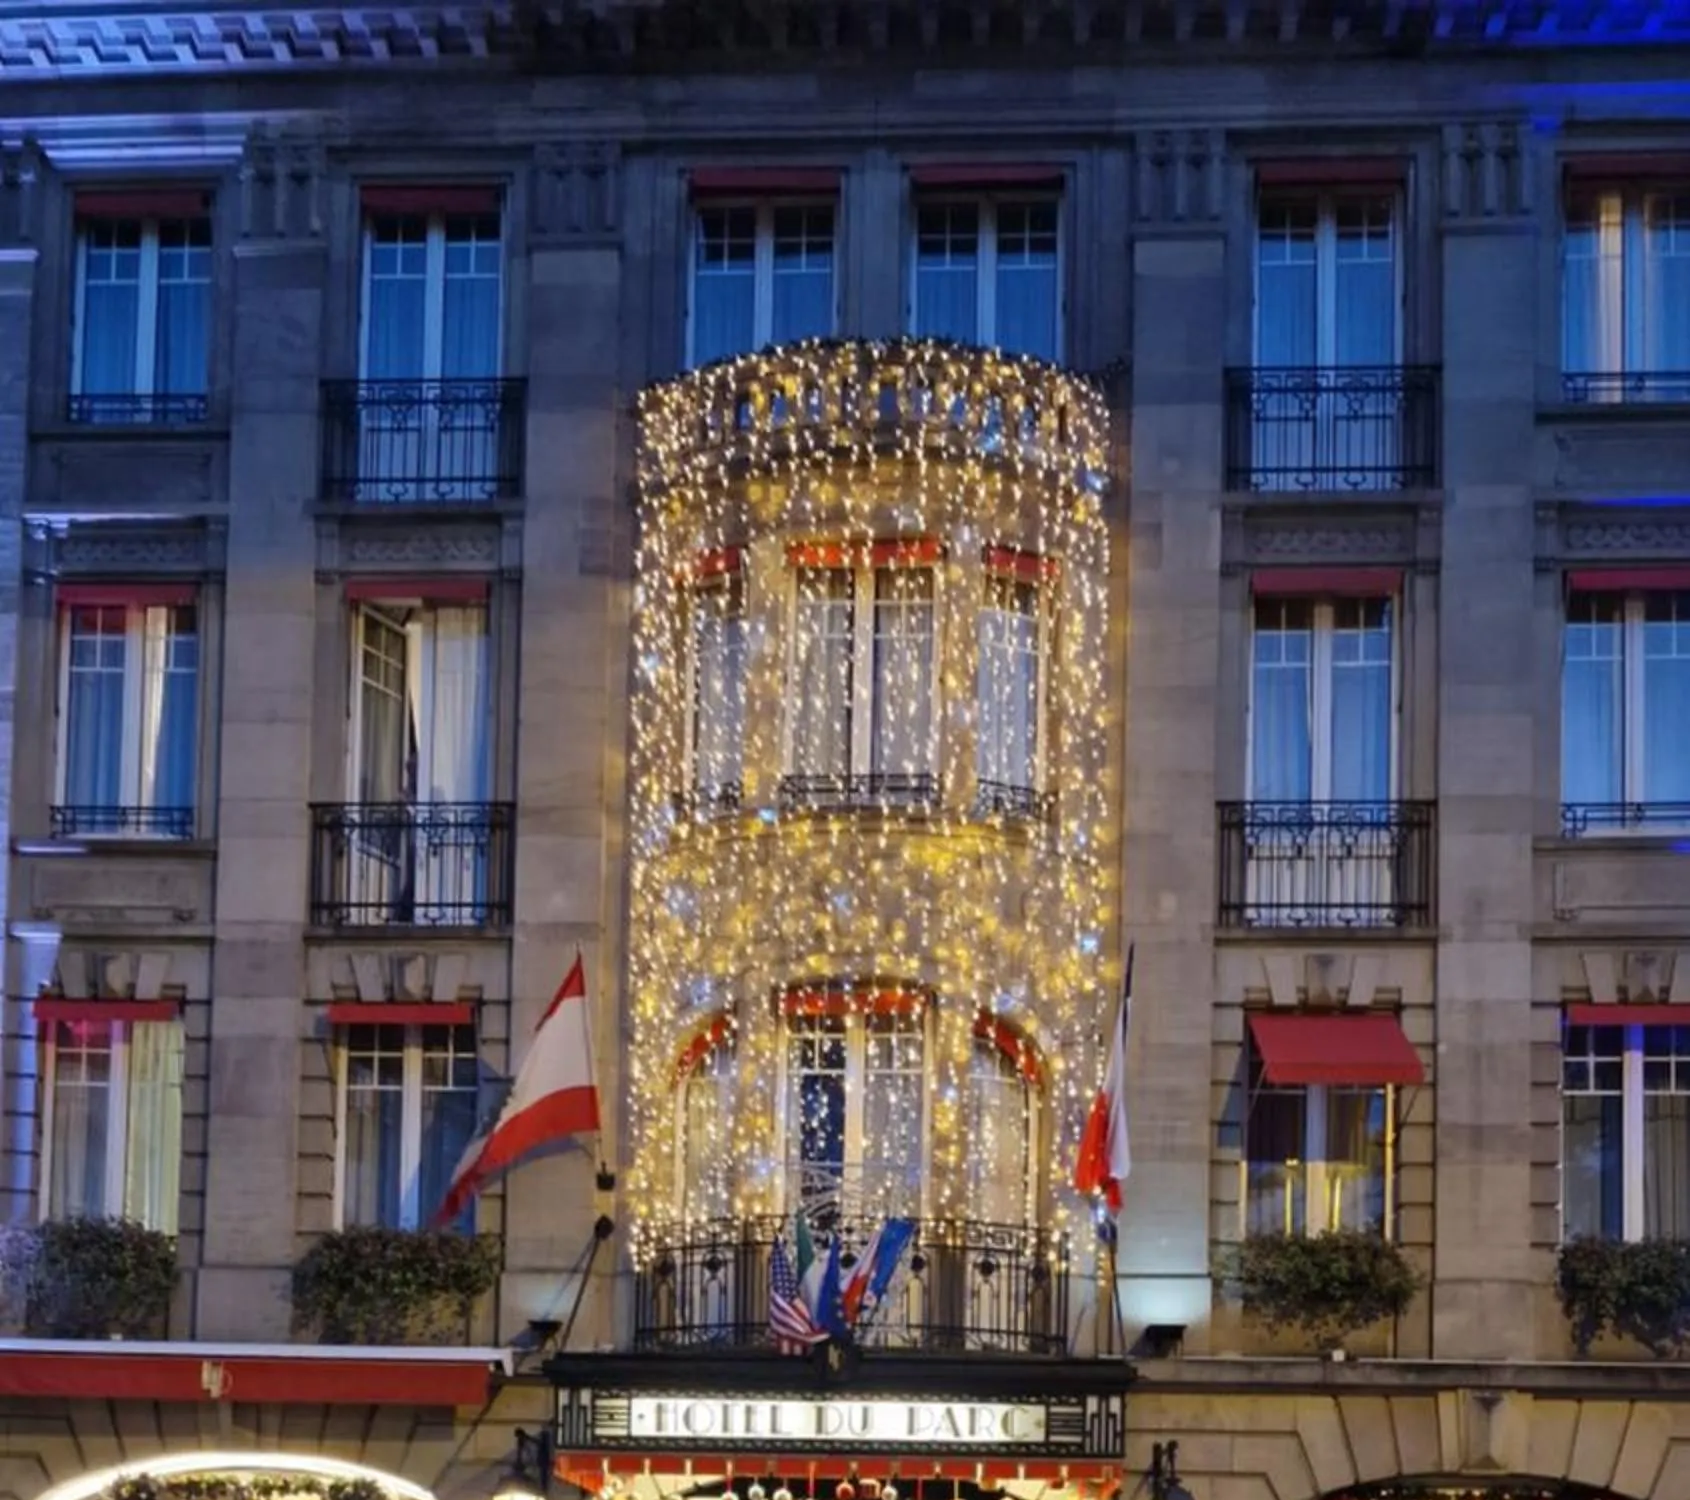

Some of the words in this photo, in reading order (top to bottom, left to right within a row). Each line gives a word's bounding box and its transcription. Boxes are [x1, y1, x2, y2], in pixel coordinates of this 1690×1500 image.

[655, 1402, 793, 1436] HOTEL
[815, 1404, 874, 1438] DU
[907, 1405, 1031, 1438] PARC
